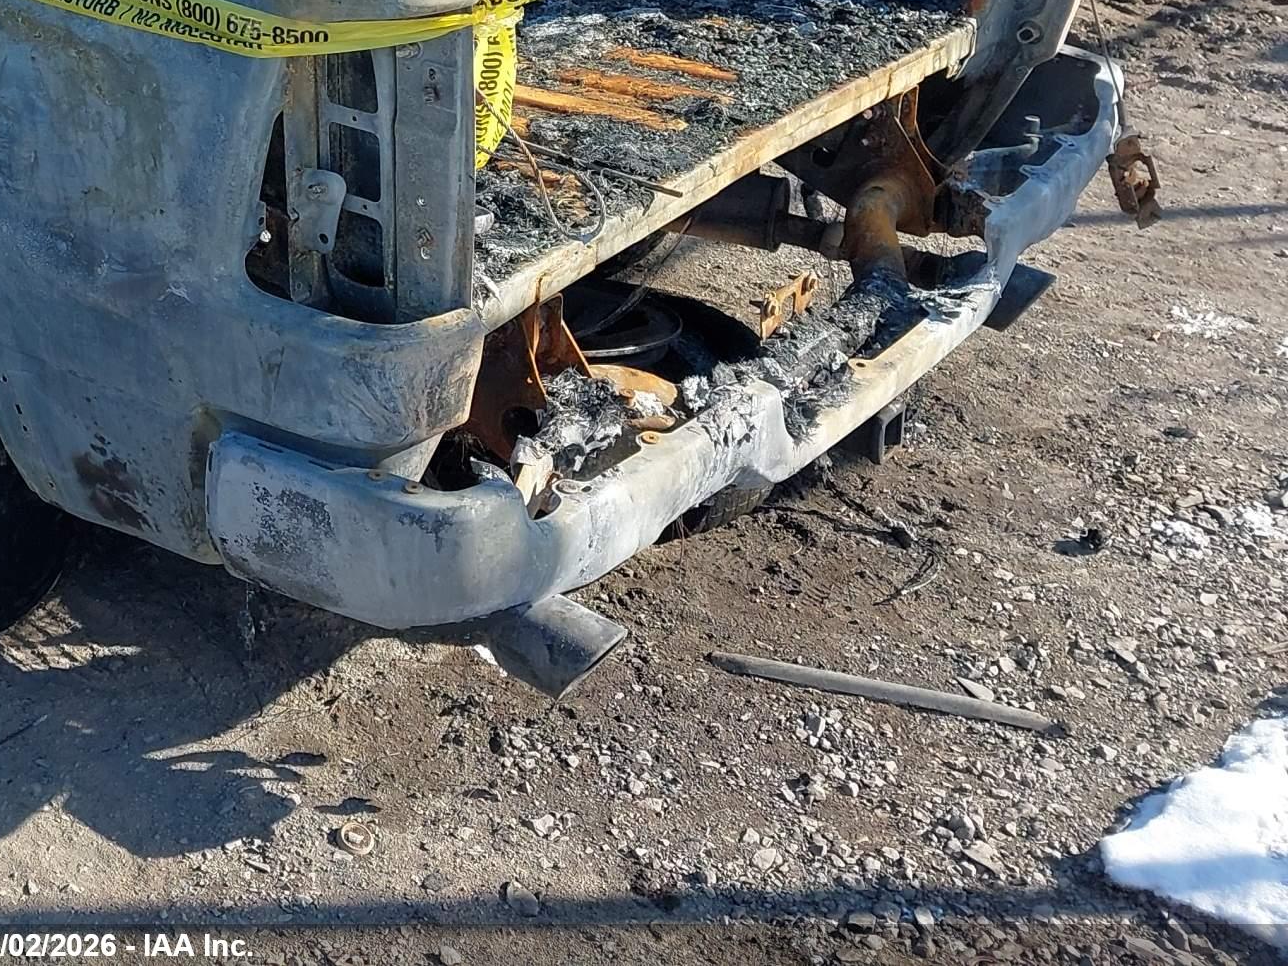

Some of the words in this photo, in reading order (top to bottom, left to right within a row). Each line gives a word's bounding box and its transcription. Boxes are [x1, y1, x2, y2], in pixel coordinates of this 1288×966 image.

[119, 5, 133, 20] /
[226, 12, 329, 45] 675-8500
[478, 52, 504, 98] (800)
